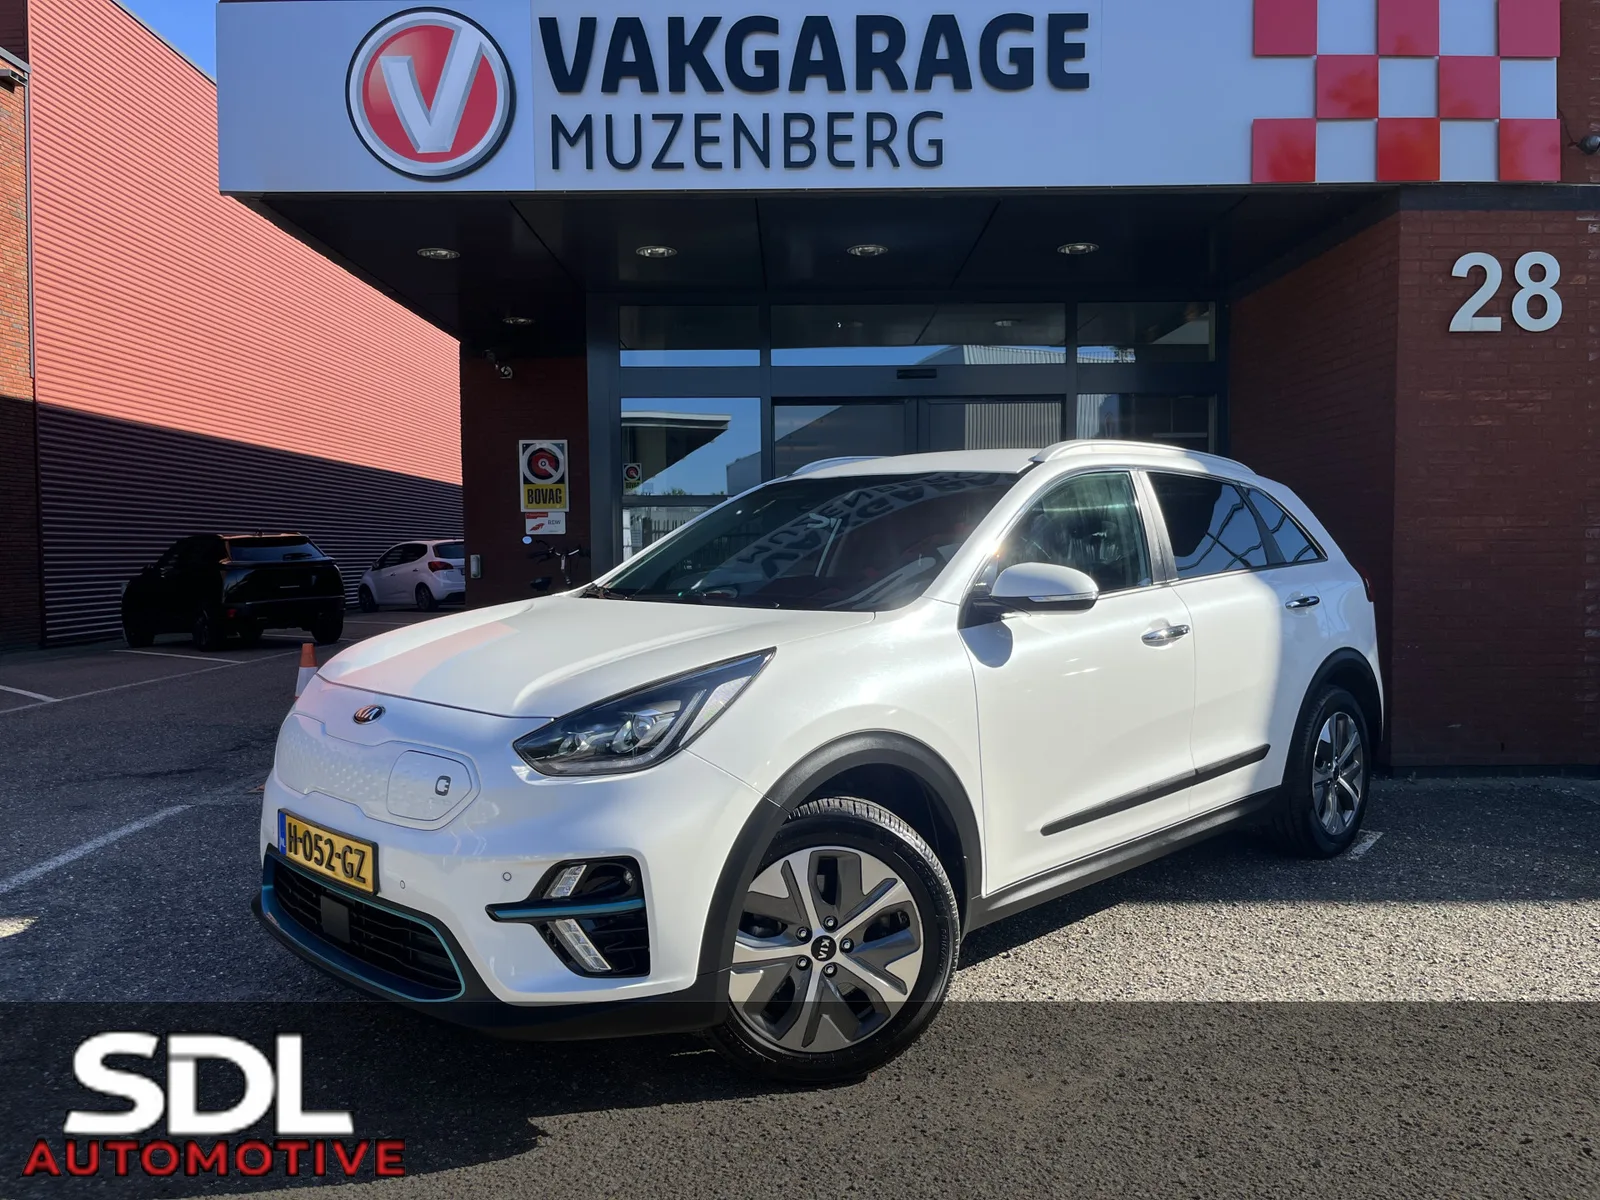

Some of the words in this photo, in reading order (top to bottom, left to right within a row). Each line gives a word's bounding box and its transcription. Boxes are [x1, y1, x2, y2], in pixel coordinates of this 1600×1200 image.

[538, 13, 1090, 93] VAKGARAGE
[551, 110, 944, 170] MUZENBERG
[1449, 251, 1562, 332] 28
[527, 488, 562, 504] BOVAG
[287, 822, 366, 884] H-052-GZ
[817, 938, 831, 959] KIA
